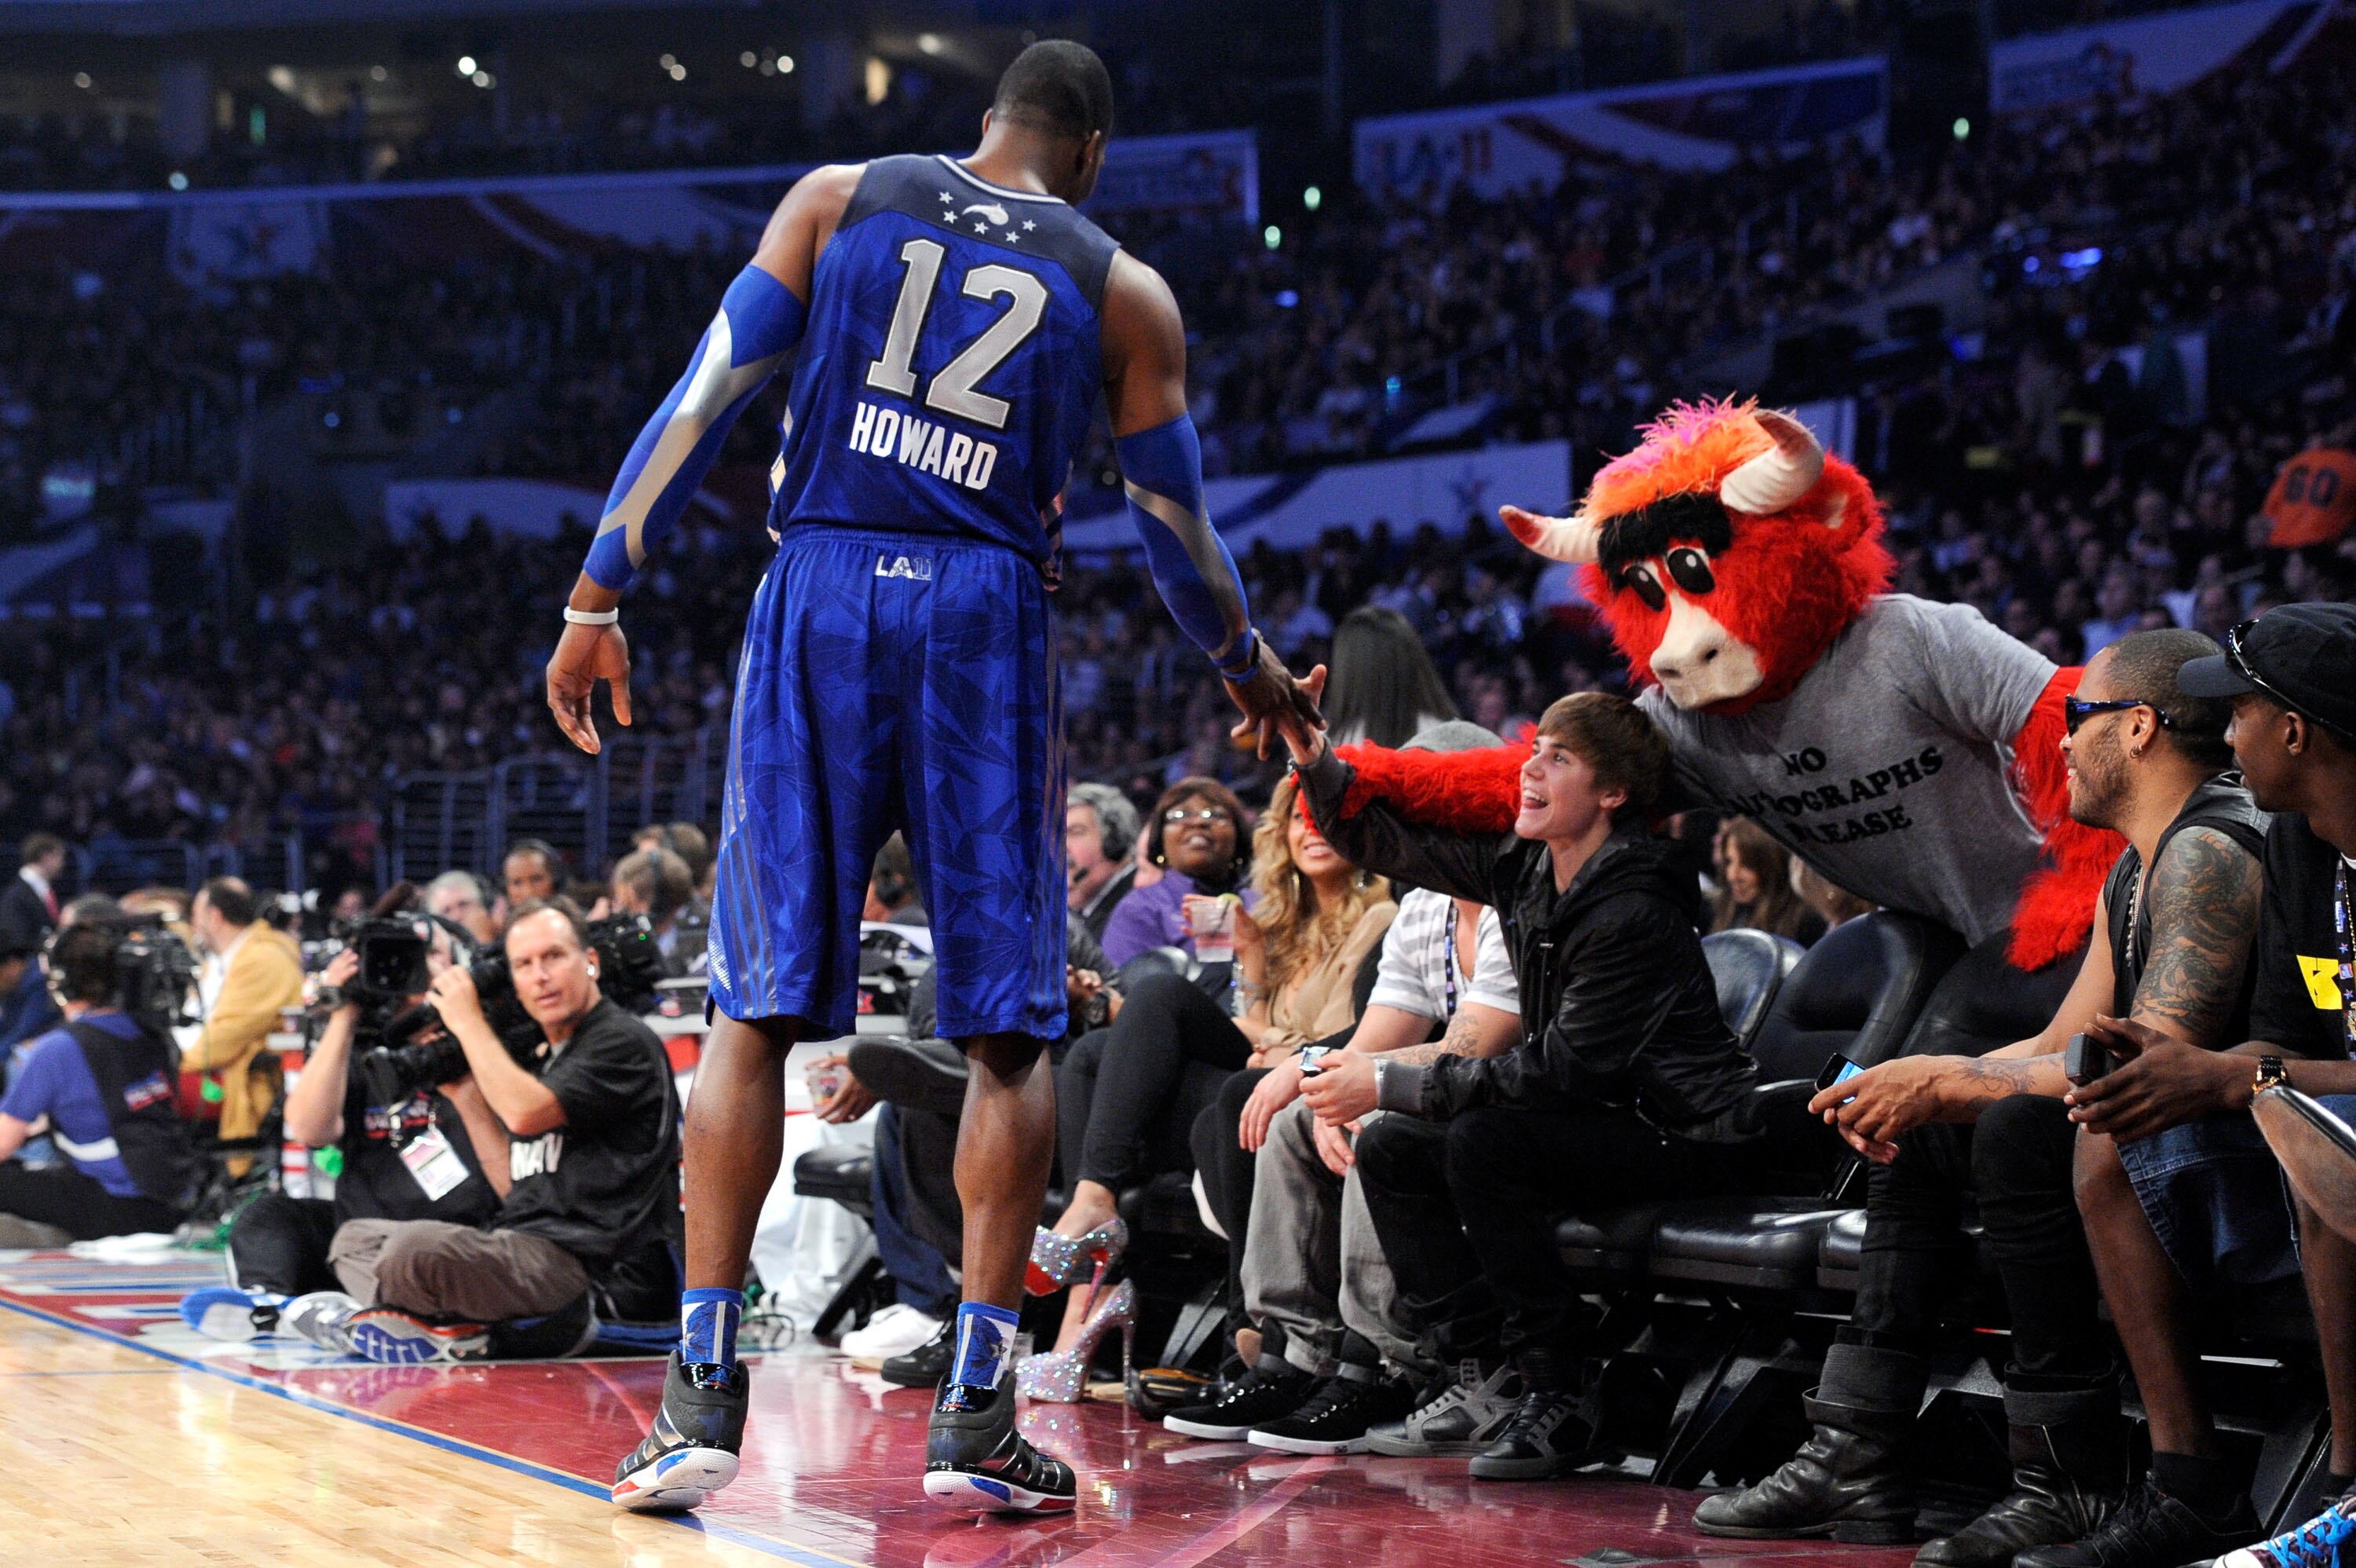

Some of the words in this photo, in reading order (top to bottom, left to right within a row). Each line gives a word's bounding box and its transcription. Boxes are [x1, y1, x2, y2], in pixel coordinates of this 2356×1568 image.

[865, 239, 1049, 429] 12
[849, 402, 998, 490] HOWARD
[1786, 747, 1827, 776] NO
